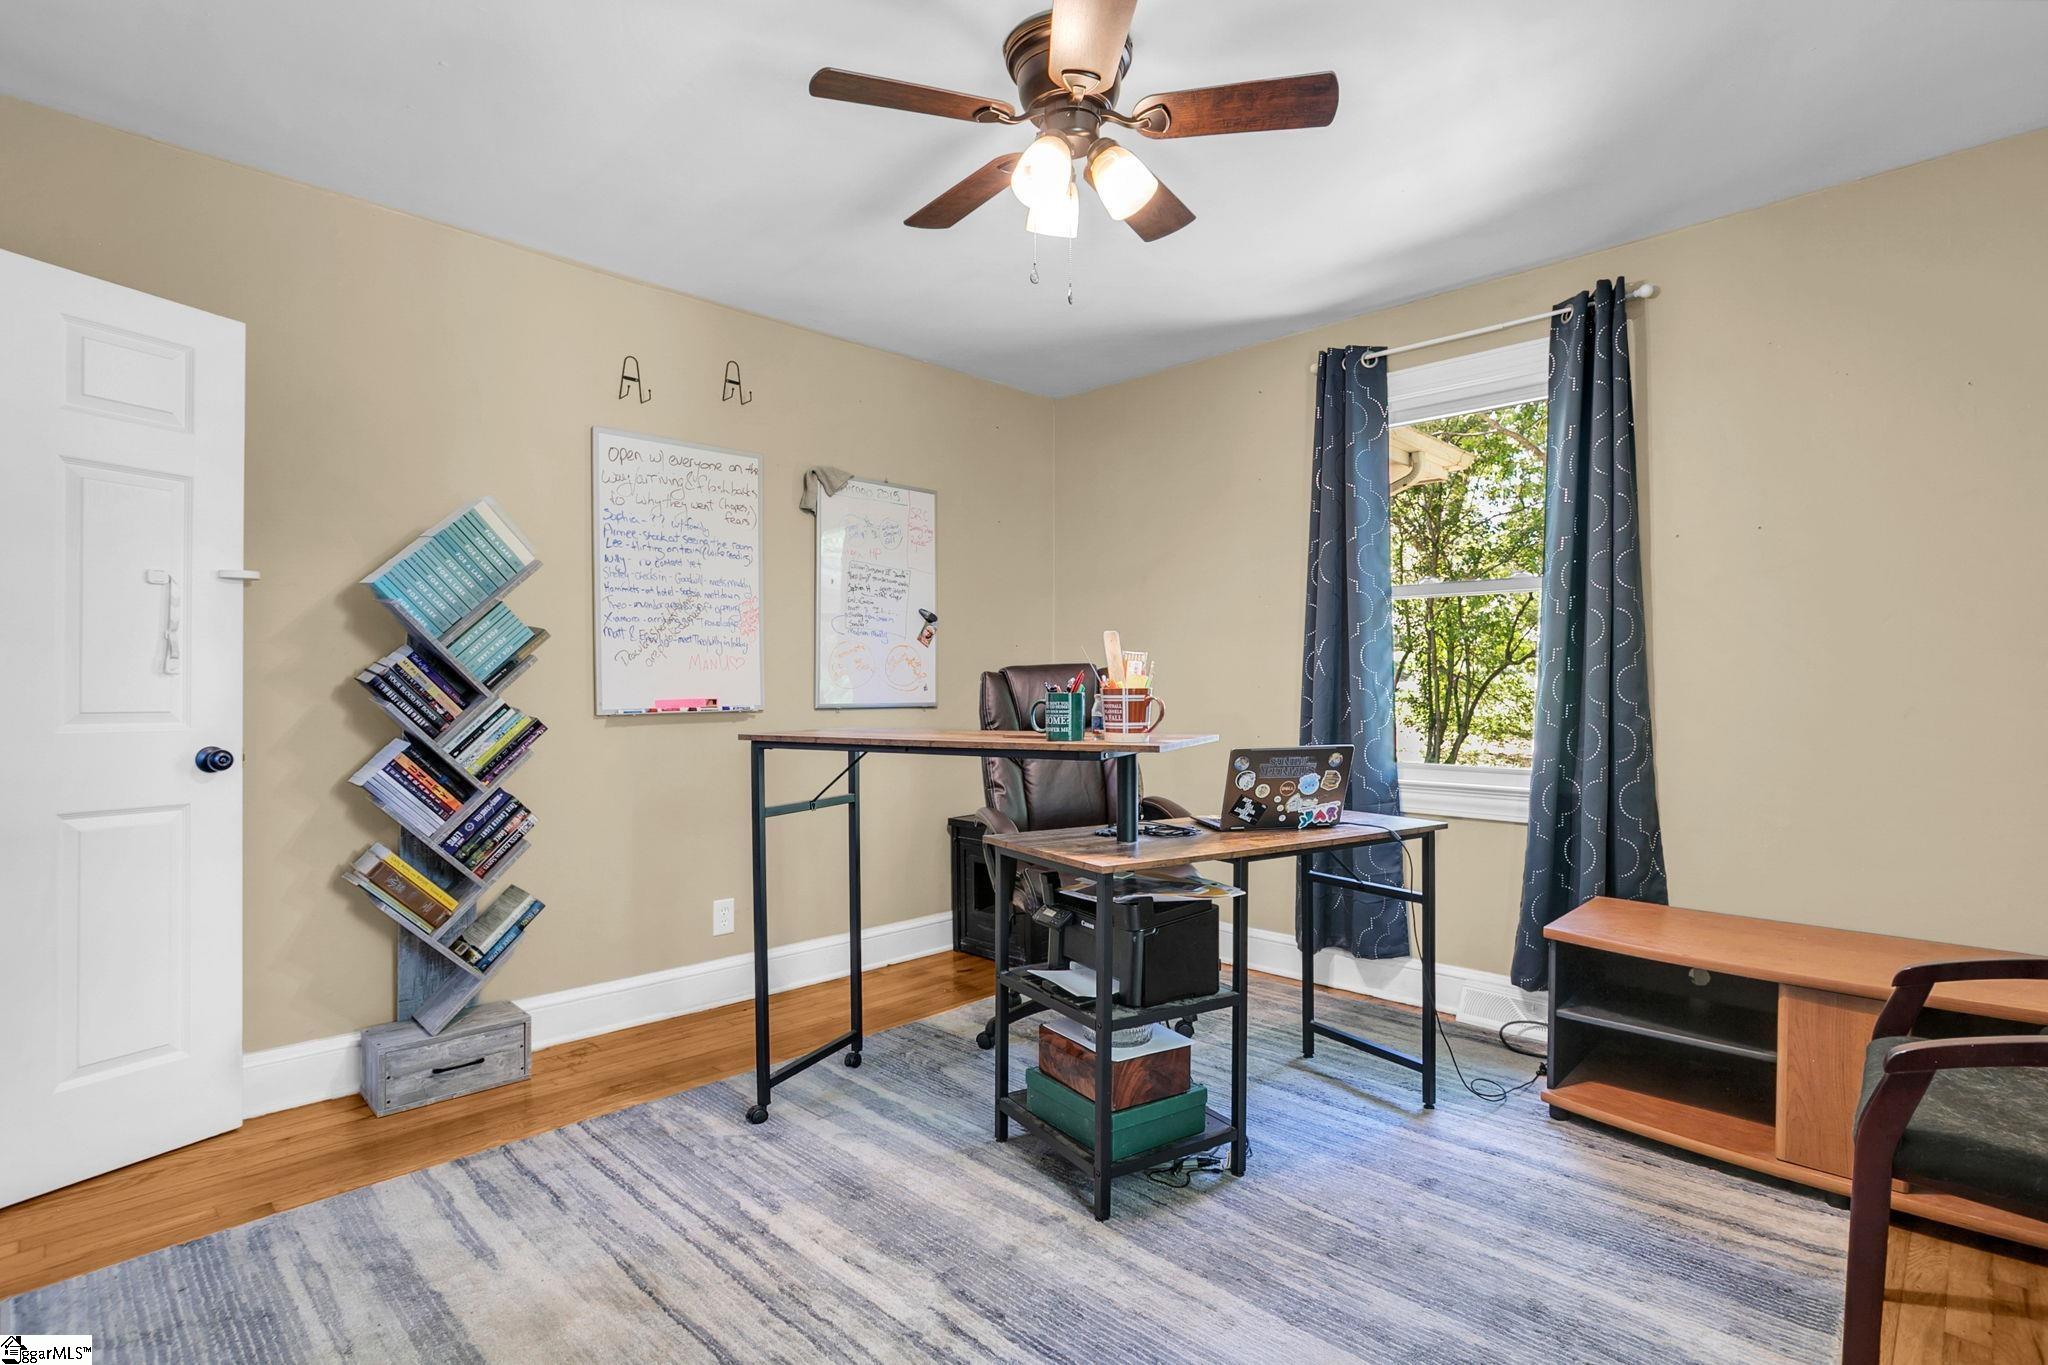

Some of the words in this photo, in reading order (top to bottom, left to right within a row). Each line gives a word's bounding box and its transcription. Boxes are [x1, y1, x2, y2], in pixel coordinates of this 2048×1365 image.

[608, 447, 643, 465] Open
[669, 455, 722, 471] everyone
[729, 464, 743, 475] on
[745, 463, 759, 475] the
[610, 491, 625, 506] to
[691, 501, 714, 511] went
